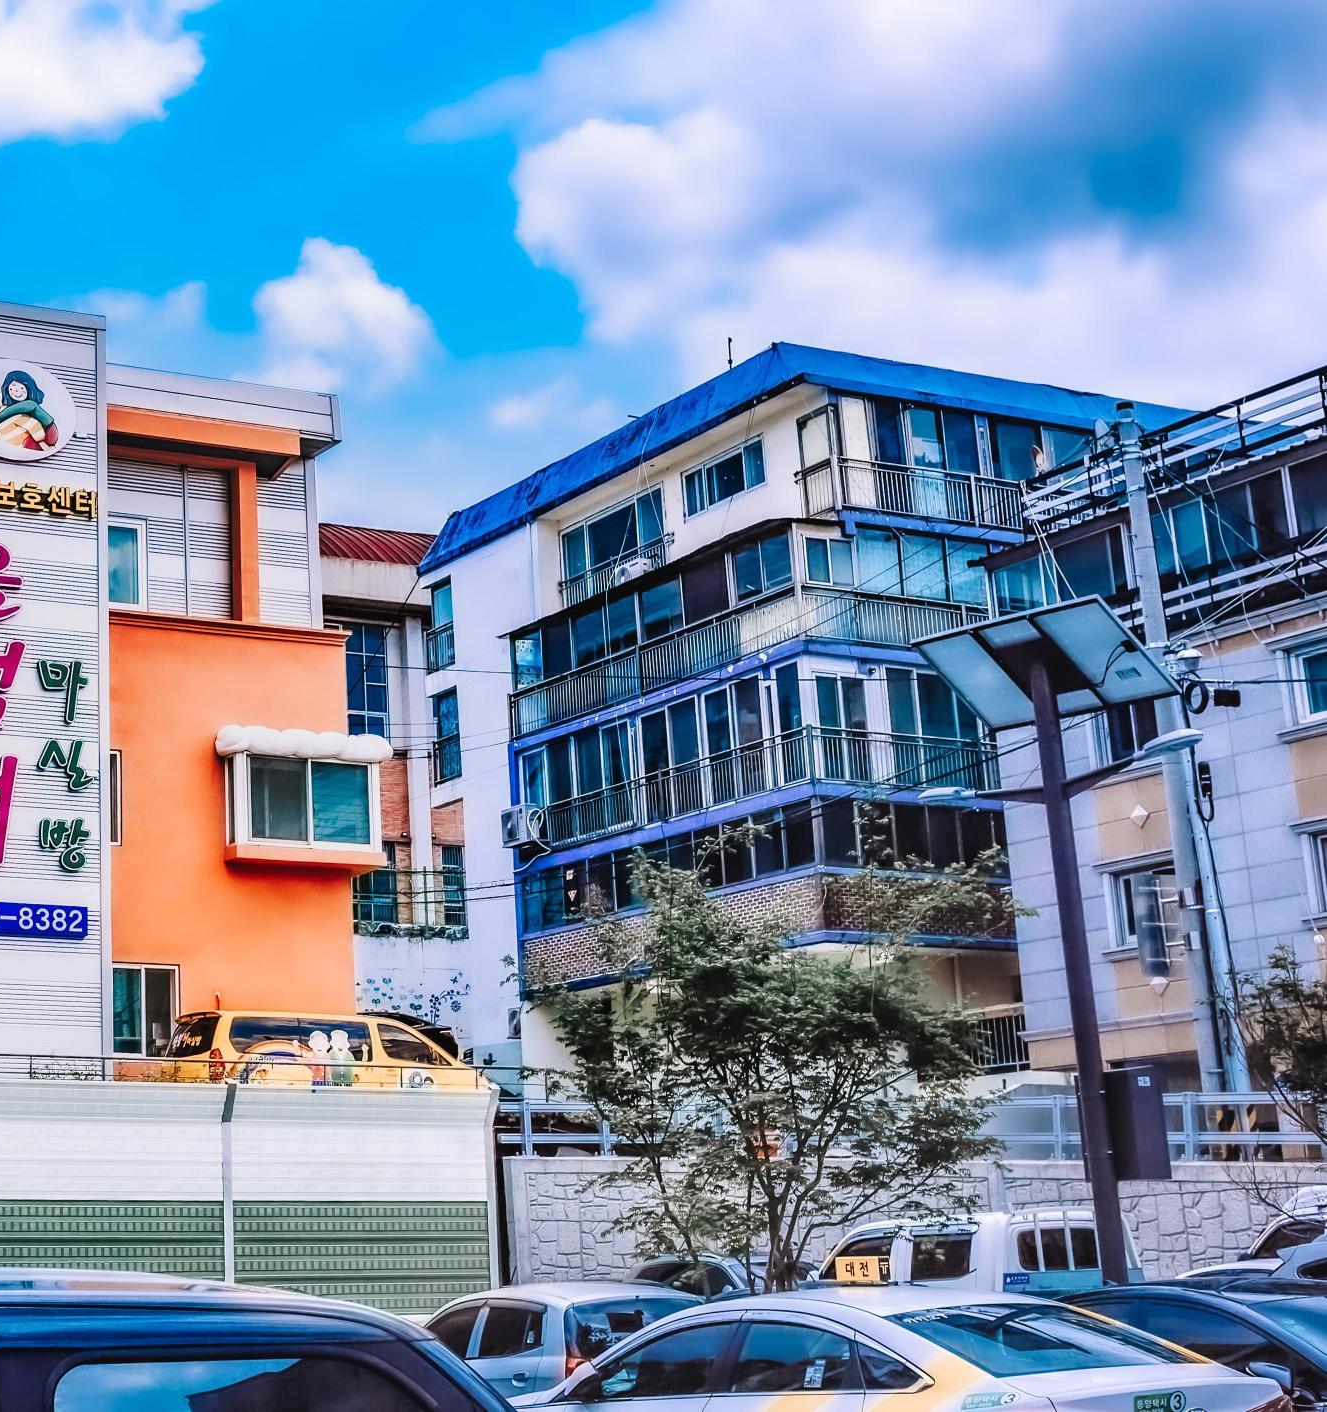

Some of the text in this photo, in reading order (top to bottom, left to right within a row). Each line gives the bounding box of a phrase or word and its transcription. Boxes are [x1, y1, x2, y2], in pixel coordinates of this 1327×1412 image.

[37, 658, 95, 871] 마실방
[845, 1261, 869, 1278] 대전
[1003, 1393, 1016, 1404] 3
[1173, 1394, 1182, 1411] 3
